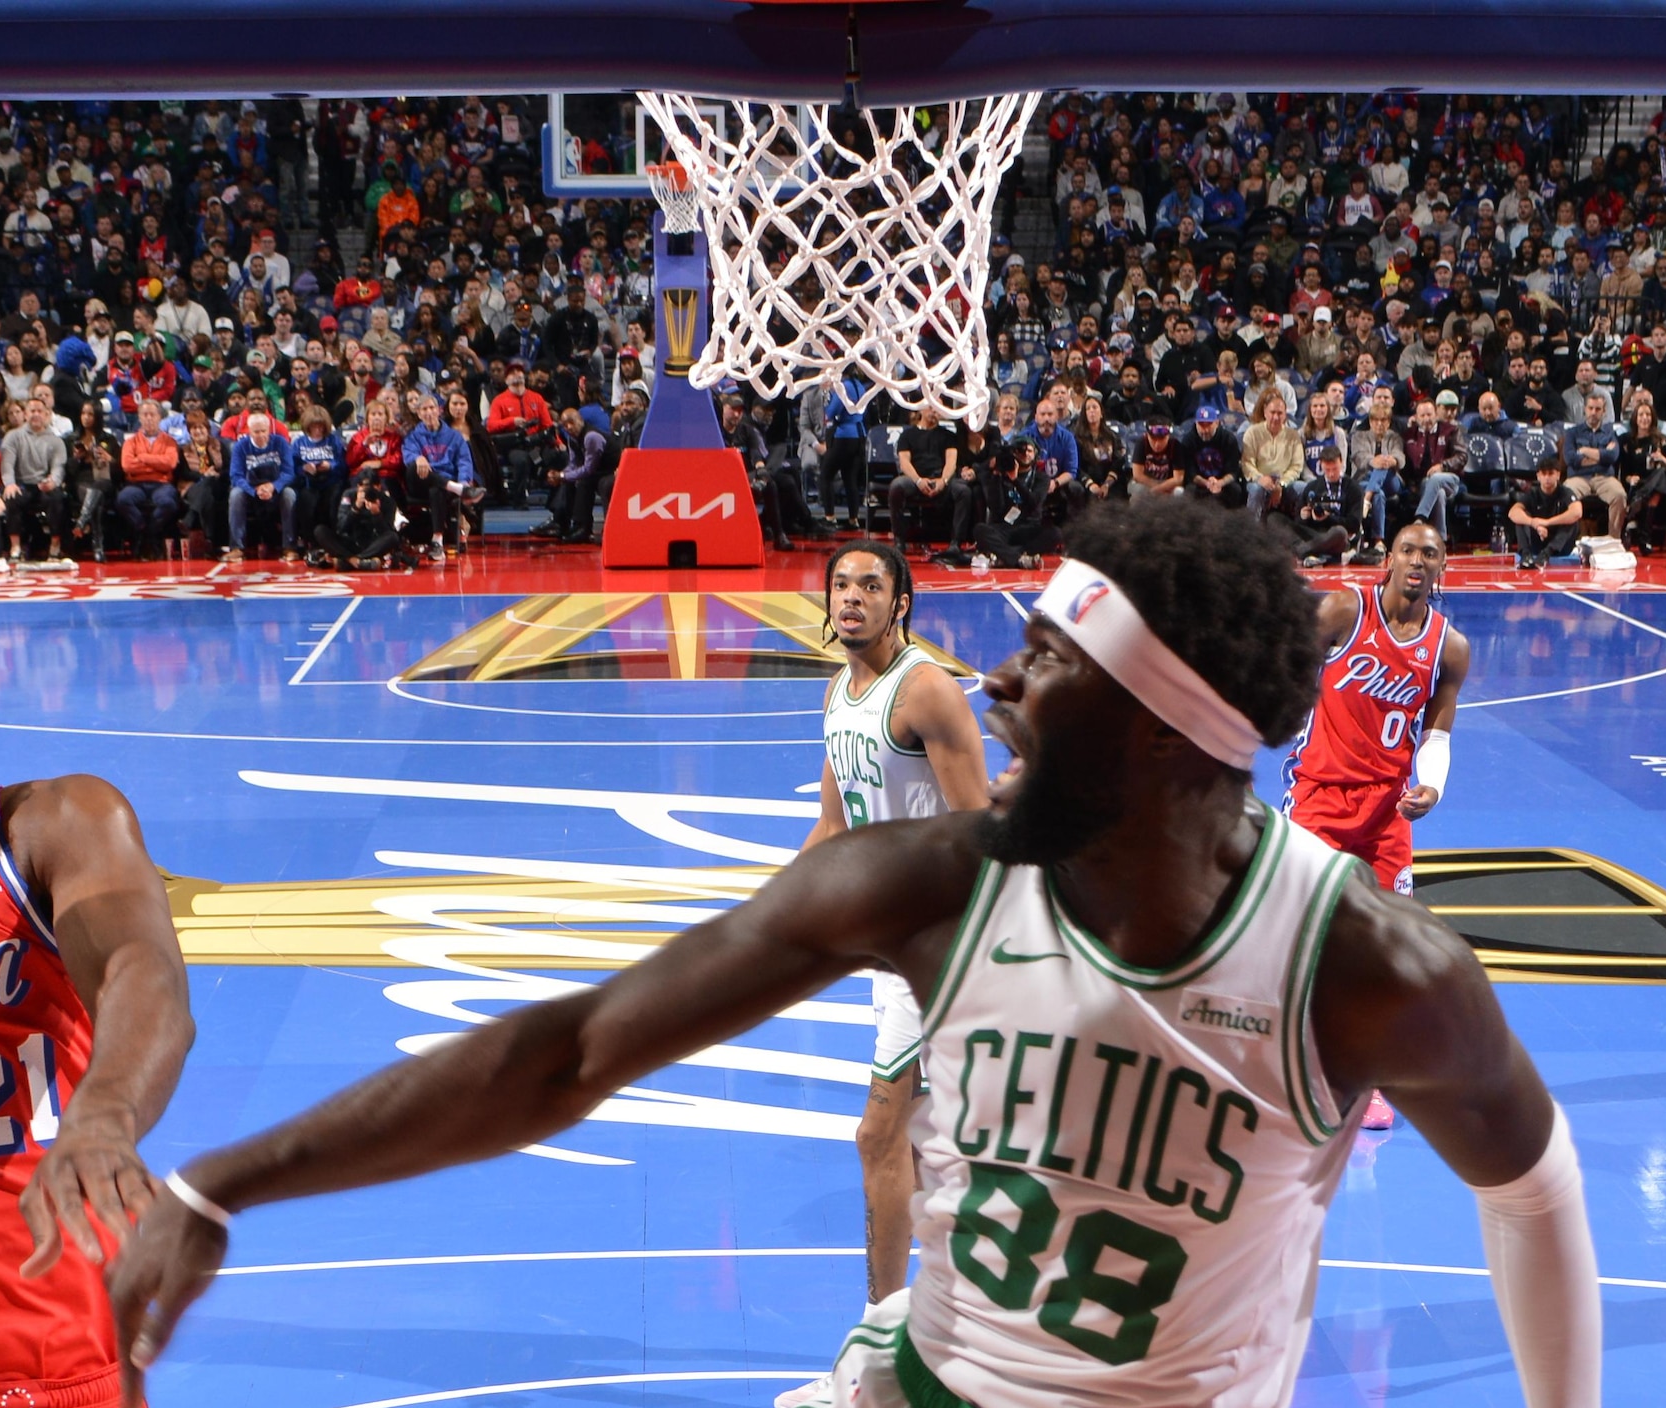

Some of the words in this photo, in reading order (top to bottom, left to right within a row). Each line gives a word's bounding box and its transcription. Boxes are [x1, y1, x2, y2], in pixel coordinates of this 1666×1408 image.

[1345, 204, 1370, 214] PHILA
[628, 492, 735, 520] KIA
[1333, 653, 1422, 706] Phila
[1380, 710, 1406, 749] 0
[1181, 997, 1272, 1037] Amica
[953, 1028, 1260, 1225] CELTICS
[947, 1162, 1188, 1367] 88
